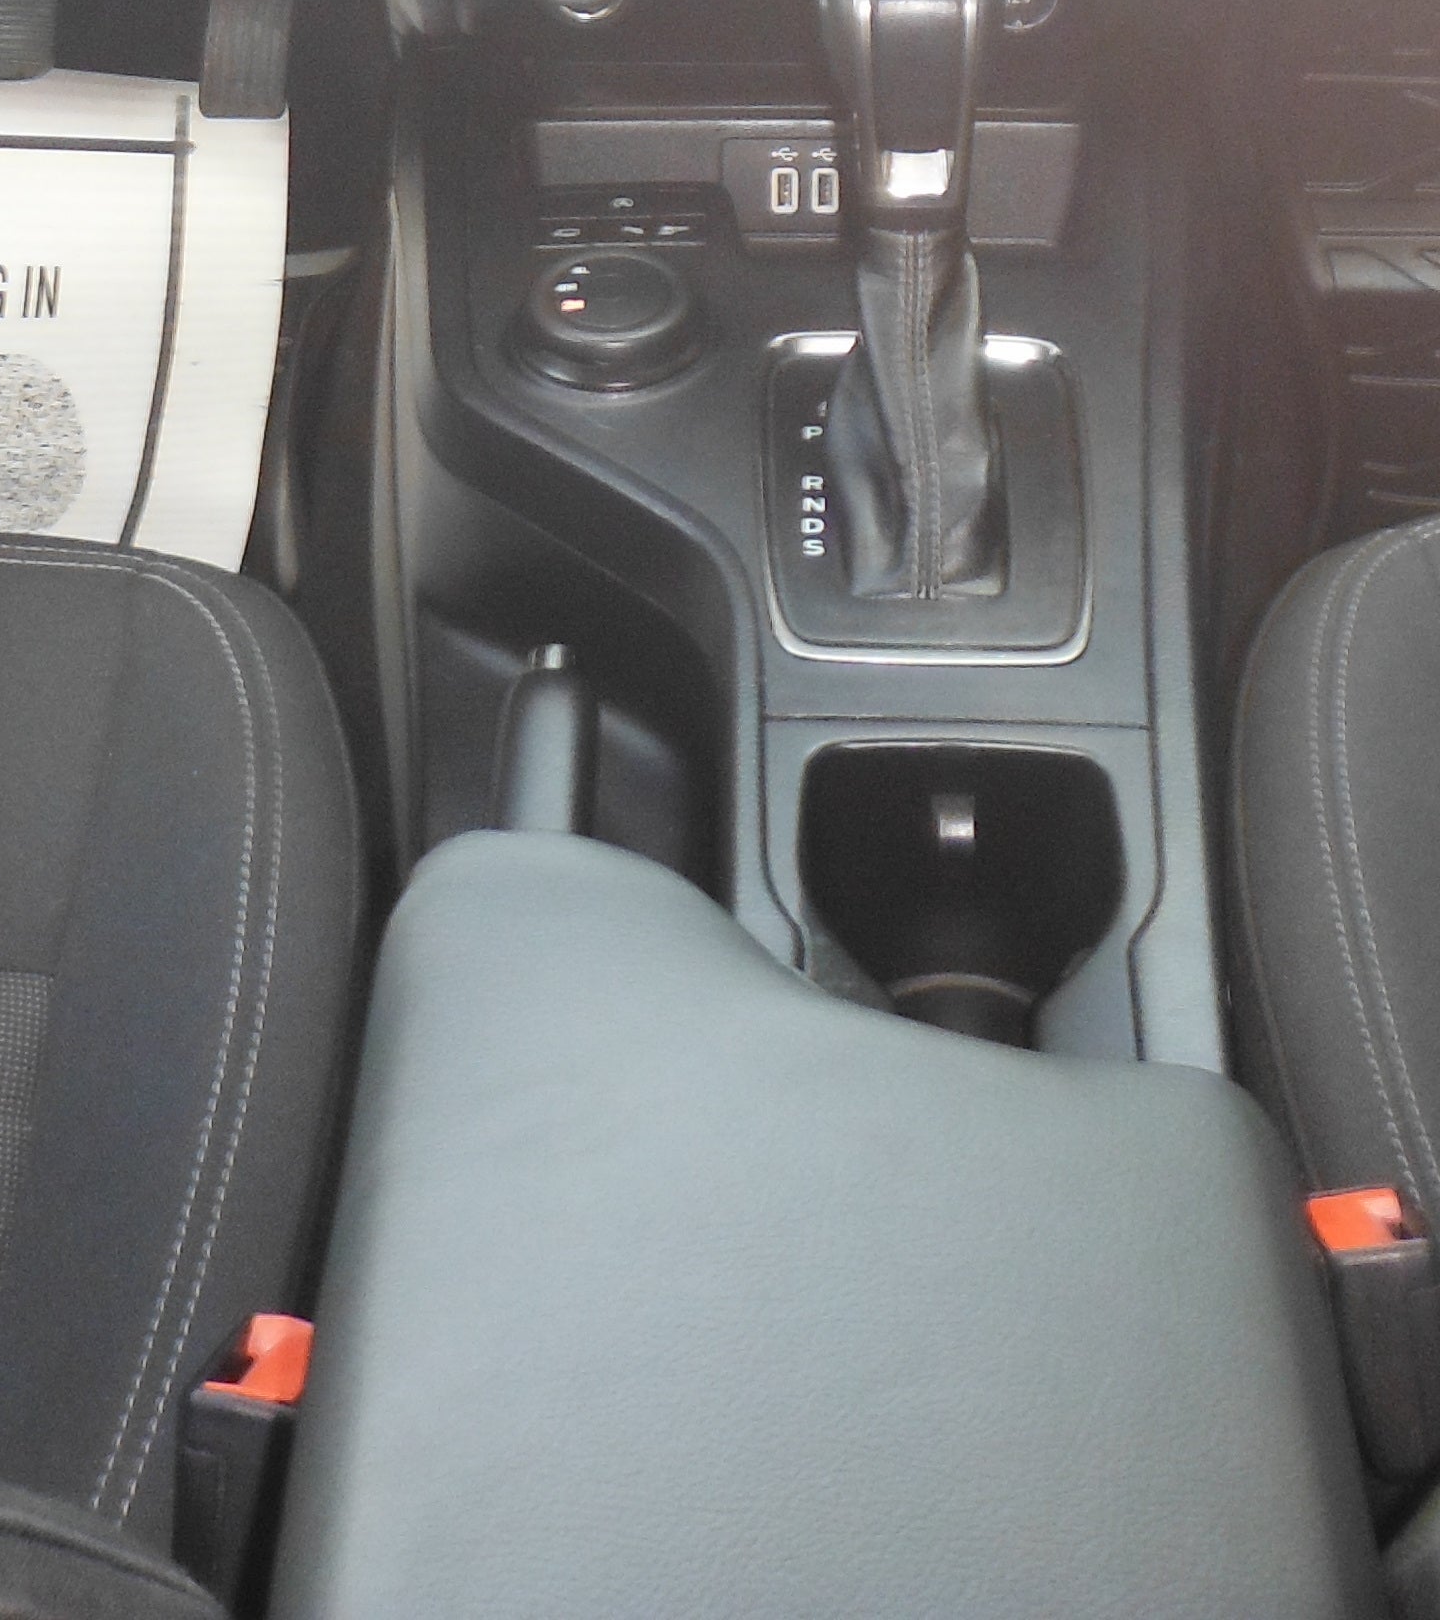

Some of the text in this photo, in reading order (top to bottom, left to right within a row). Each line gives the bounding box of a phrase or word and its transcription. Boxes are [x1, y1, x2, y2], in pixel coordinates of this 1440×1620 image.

[22, 265, 61, 319] IN
[801, 426, 824, 440] P
[801, 475, 824, 491] R
[802, 497, 826, 513] N
[801, 518, 825, 534] D
[802, 539, 825, 557] S
